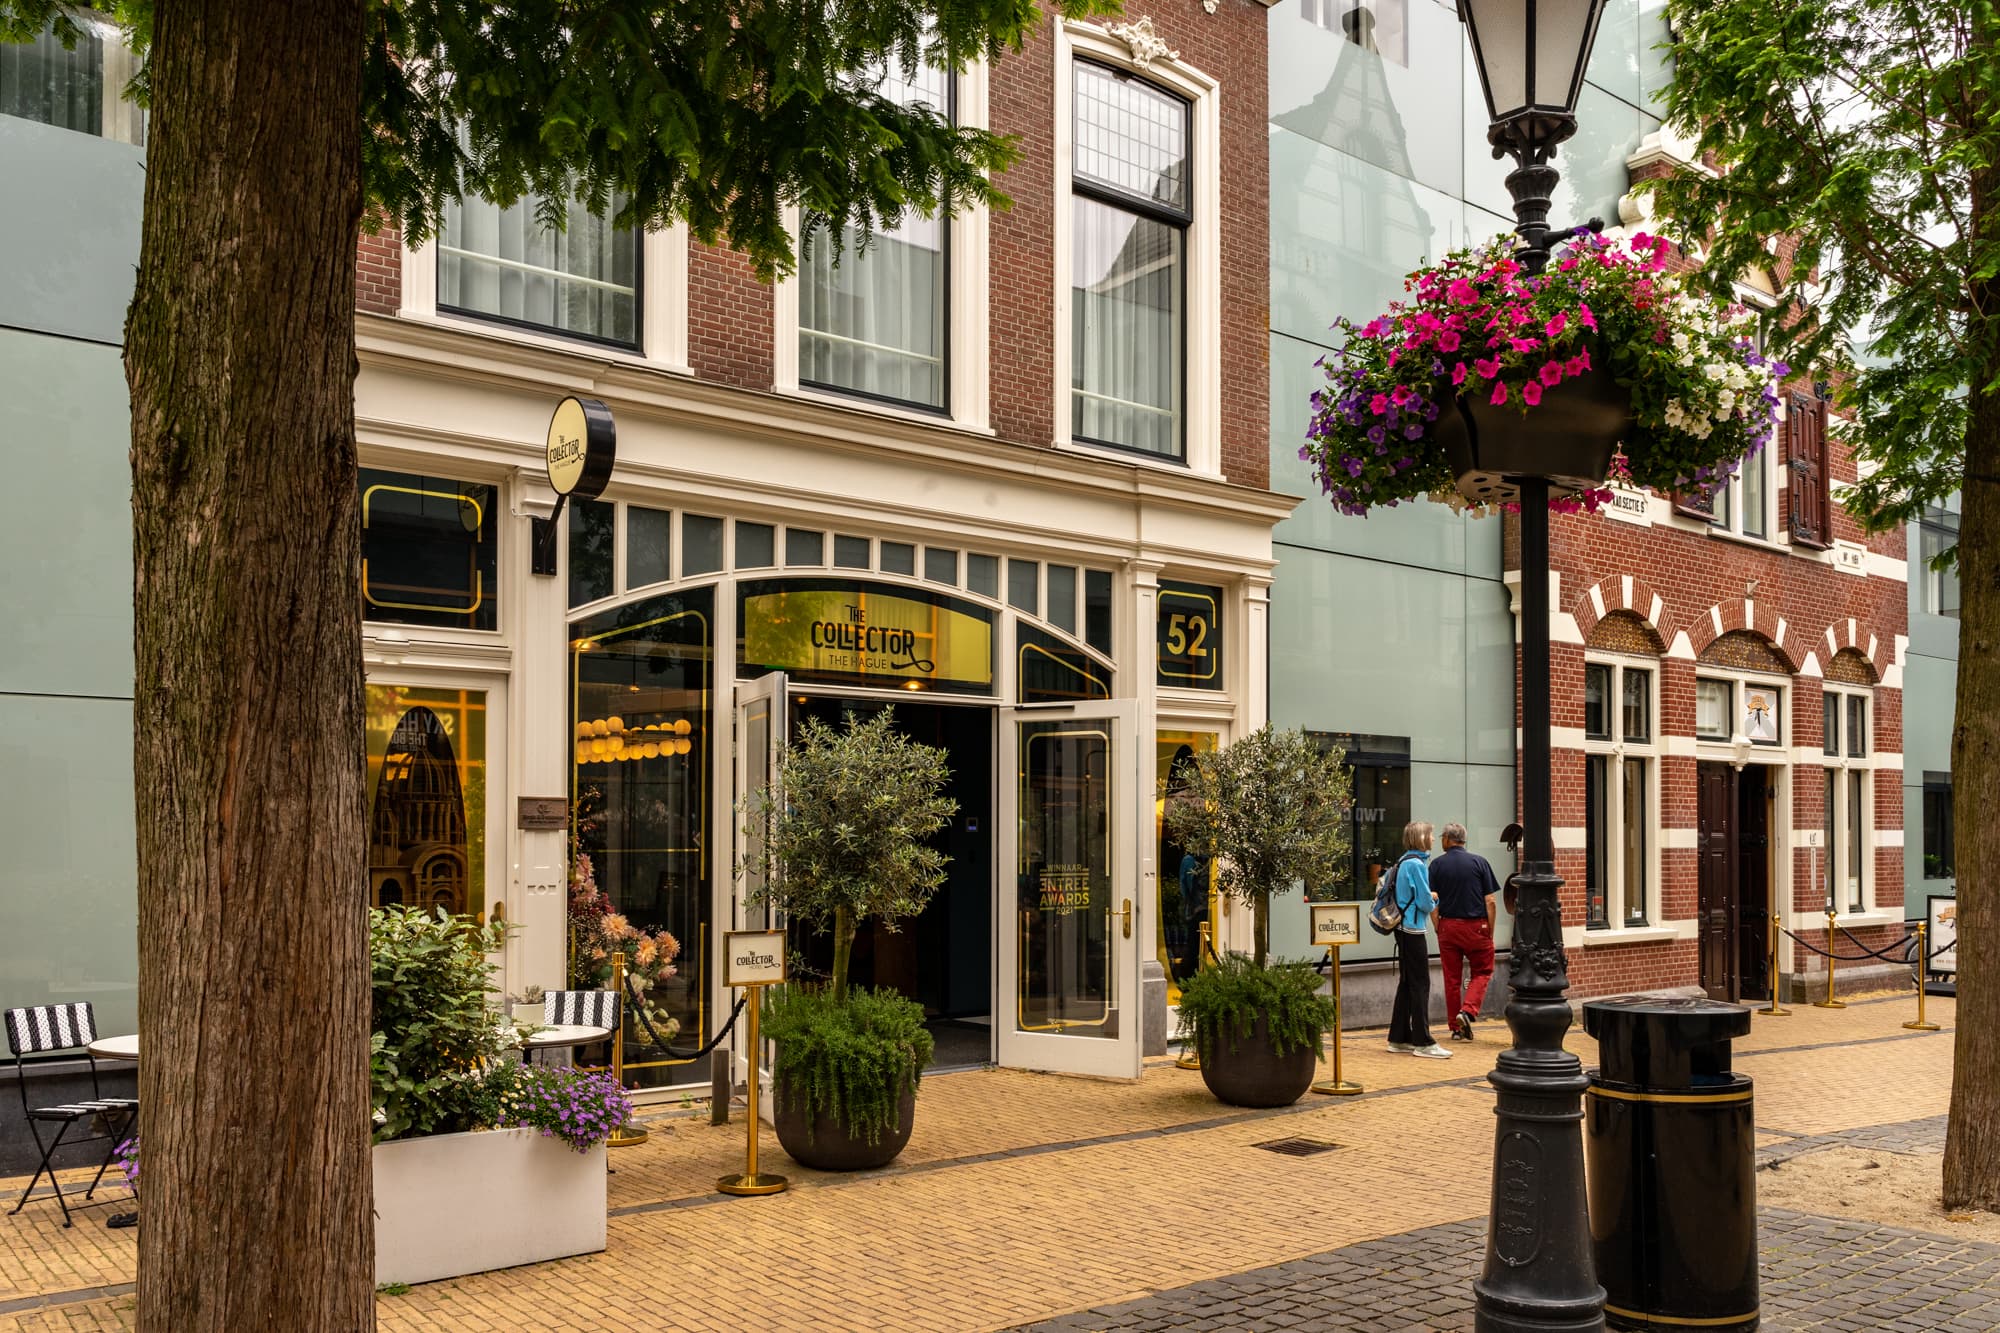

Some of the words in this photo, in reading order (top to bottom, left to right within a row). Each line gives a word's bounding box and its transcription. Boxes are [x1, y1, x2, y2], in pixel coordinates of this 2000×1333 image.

[549, 439, 585, 464] COLLECTOR
[845, 604, 866, 623] THE
[1166, 613, 1208, 657] 52
[810, 620, 935, 673] COLLECTOR
[828, 654, 848, 666] THE
[850, 654, 888, 670] HAGUE
[1047, 863, 1082, 872] WINNAAR
[1040, 892, 1089, 906] AWARDS
[1056, 906, 1073, 915] 2021
[1318, 922, 1356, 935] COLLECTOR
[736, 954, 781, 968] COLLECTOR
